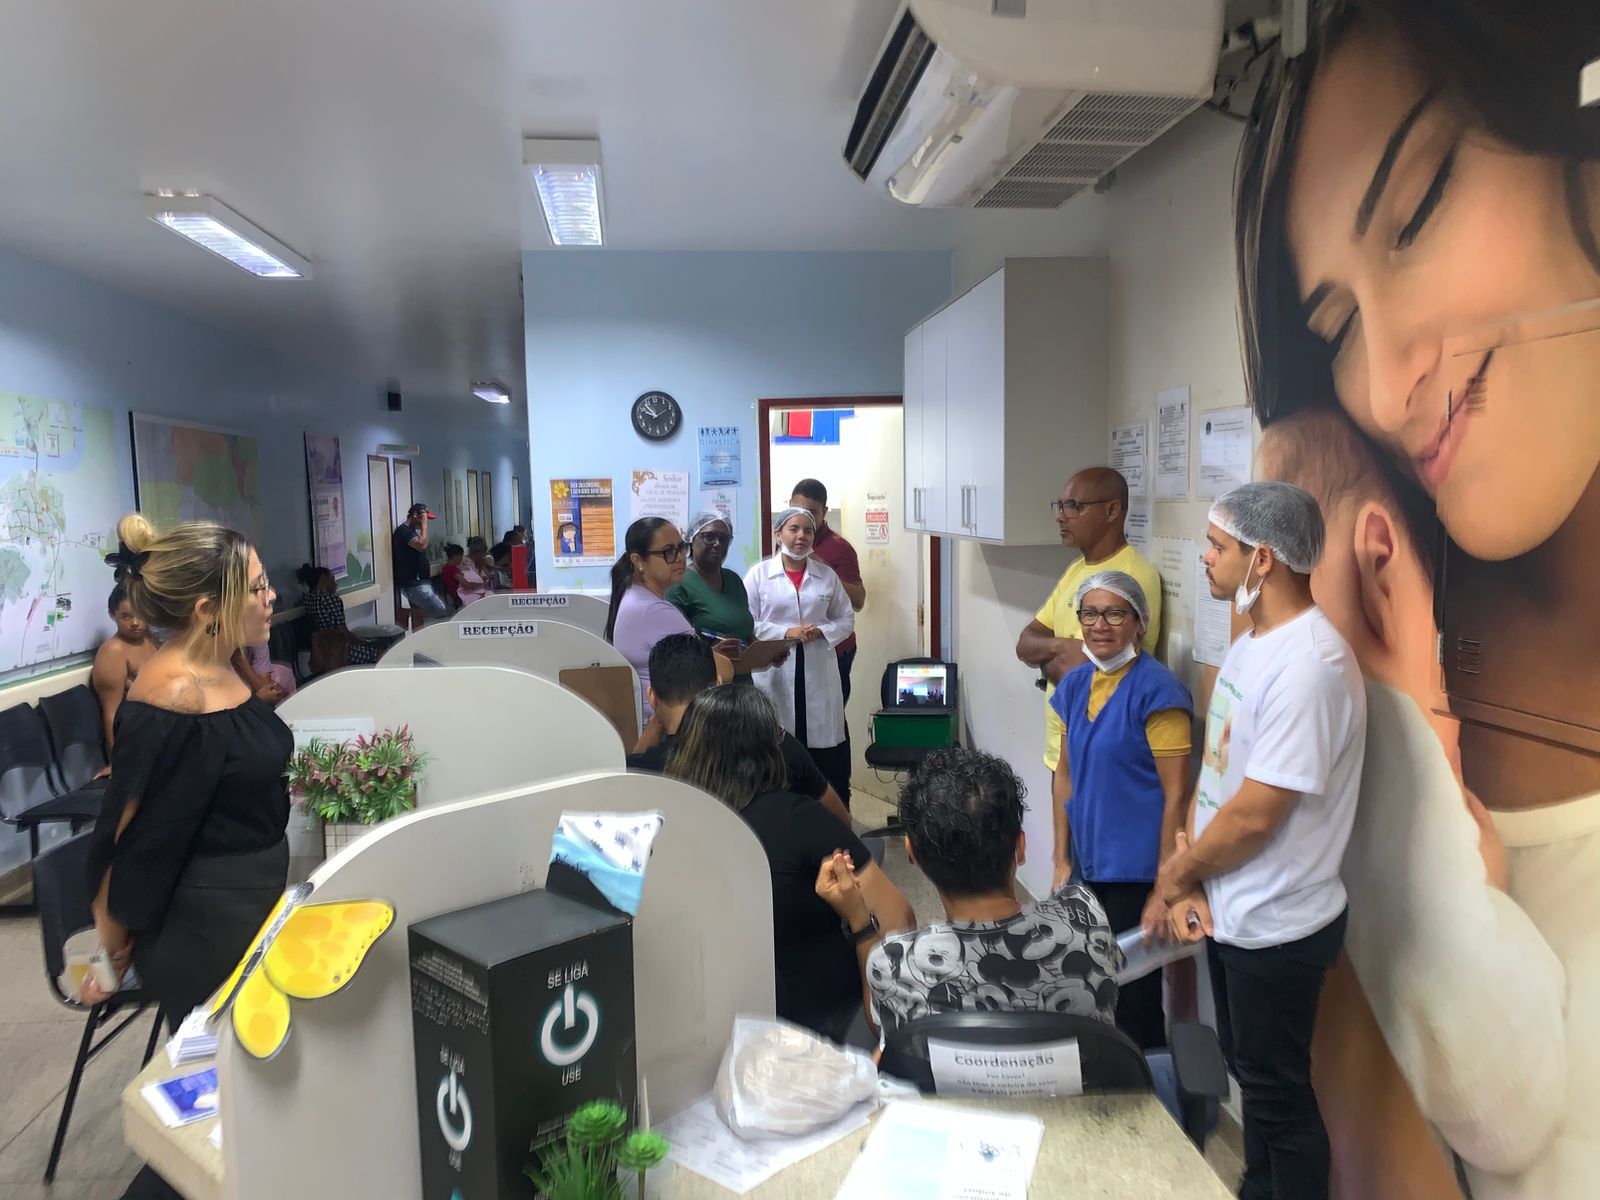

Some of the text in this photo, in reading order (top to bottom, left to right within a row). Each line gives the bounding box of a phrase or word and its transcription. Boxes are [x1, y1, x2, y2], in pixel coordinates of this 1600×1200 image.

[511, 596, 567, 606] RECEPÇÃO
[463, 623, 534, 637] RECEPÇÃO
[547, 965, 589, 990] SE LIGA
[954, 1054, 1055, 1068] Coordenação
[562, 1067, 582, 1087] USE
